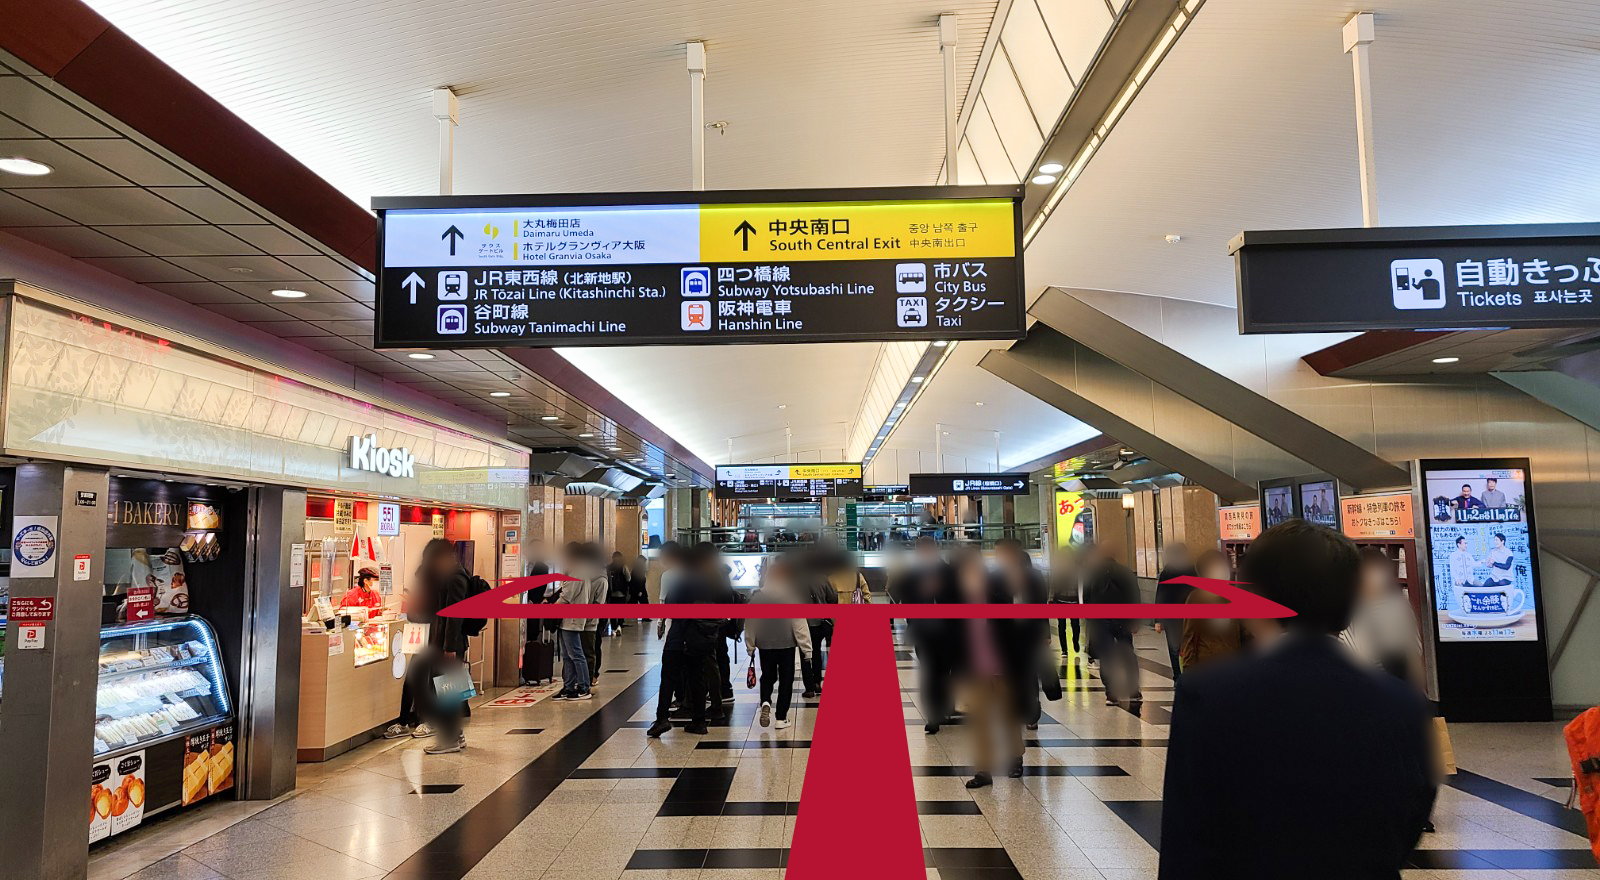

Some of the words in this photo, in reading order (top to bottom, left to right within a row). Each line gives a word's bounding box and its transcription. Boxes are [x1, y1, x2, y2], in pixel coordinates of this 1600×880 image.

[523, 219, 580, 228] 大丸梅田店
[769, 219, 849, 236] 中央南口
[909, 224, 928, 233] 중앙
[933, 223, 952, 233] 남쪽
[958, 223, 978, 232] 출구
[523, 241, 645, 251] ホテルグランヴィア大阪
[770, 239, 812, 251] South
[817, 238, 868, 250] Central
[874, 237, 900, 249] Exit
[910, 238, 965, 248] 中央南出口
[474, 270, 631, 285] JR東西線（北新地駅）
[718, 266, 790, 282] 四つ橋線
[934, 262, 987, 278] 市バス
[474, 289, 487, 300] JR
[492, 289, 524, 299] Tōzai
[529, 288, 556, 299] Line
[560, 287, 634, 299] (Kitashinchi
[639, 286, 665, 297] Sta.)
[719, 285, 769, 298] Subway
[772, 283, 842, 295] Yotsubashi
[848, 283, 874, 294] Line
[935, 282, 959, 295] City
[964, 281, 986, 292] Bus
[1457, 291, 1522, 306] Tickets
[1534, 290, 1592, 303] 표사는곳
[474, 304, 528, 320] 谷町線
[719, 300, 791, 316] 阪神電車
[935, 297, 1004, 312] タクシー
[719, 318, 771, 330] Hanshin
[776, 319, 802, 329] Line
[936, 315, 961, 326] Taxi
[475, 322, 525, 336] Subway
[529, 321, 594, 333] Tanimachi
[599, 321, 626, 332] Line
[350, 433, 415, 478] Kiosk
[123, 500, 182, 526] BAKERY
[383, 507, 394, 522] 551
[1347, 501, 1406, 514] 新幹線・特急列車の旅を
